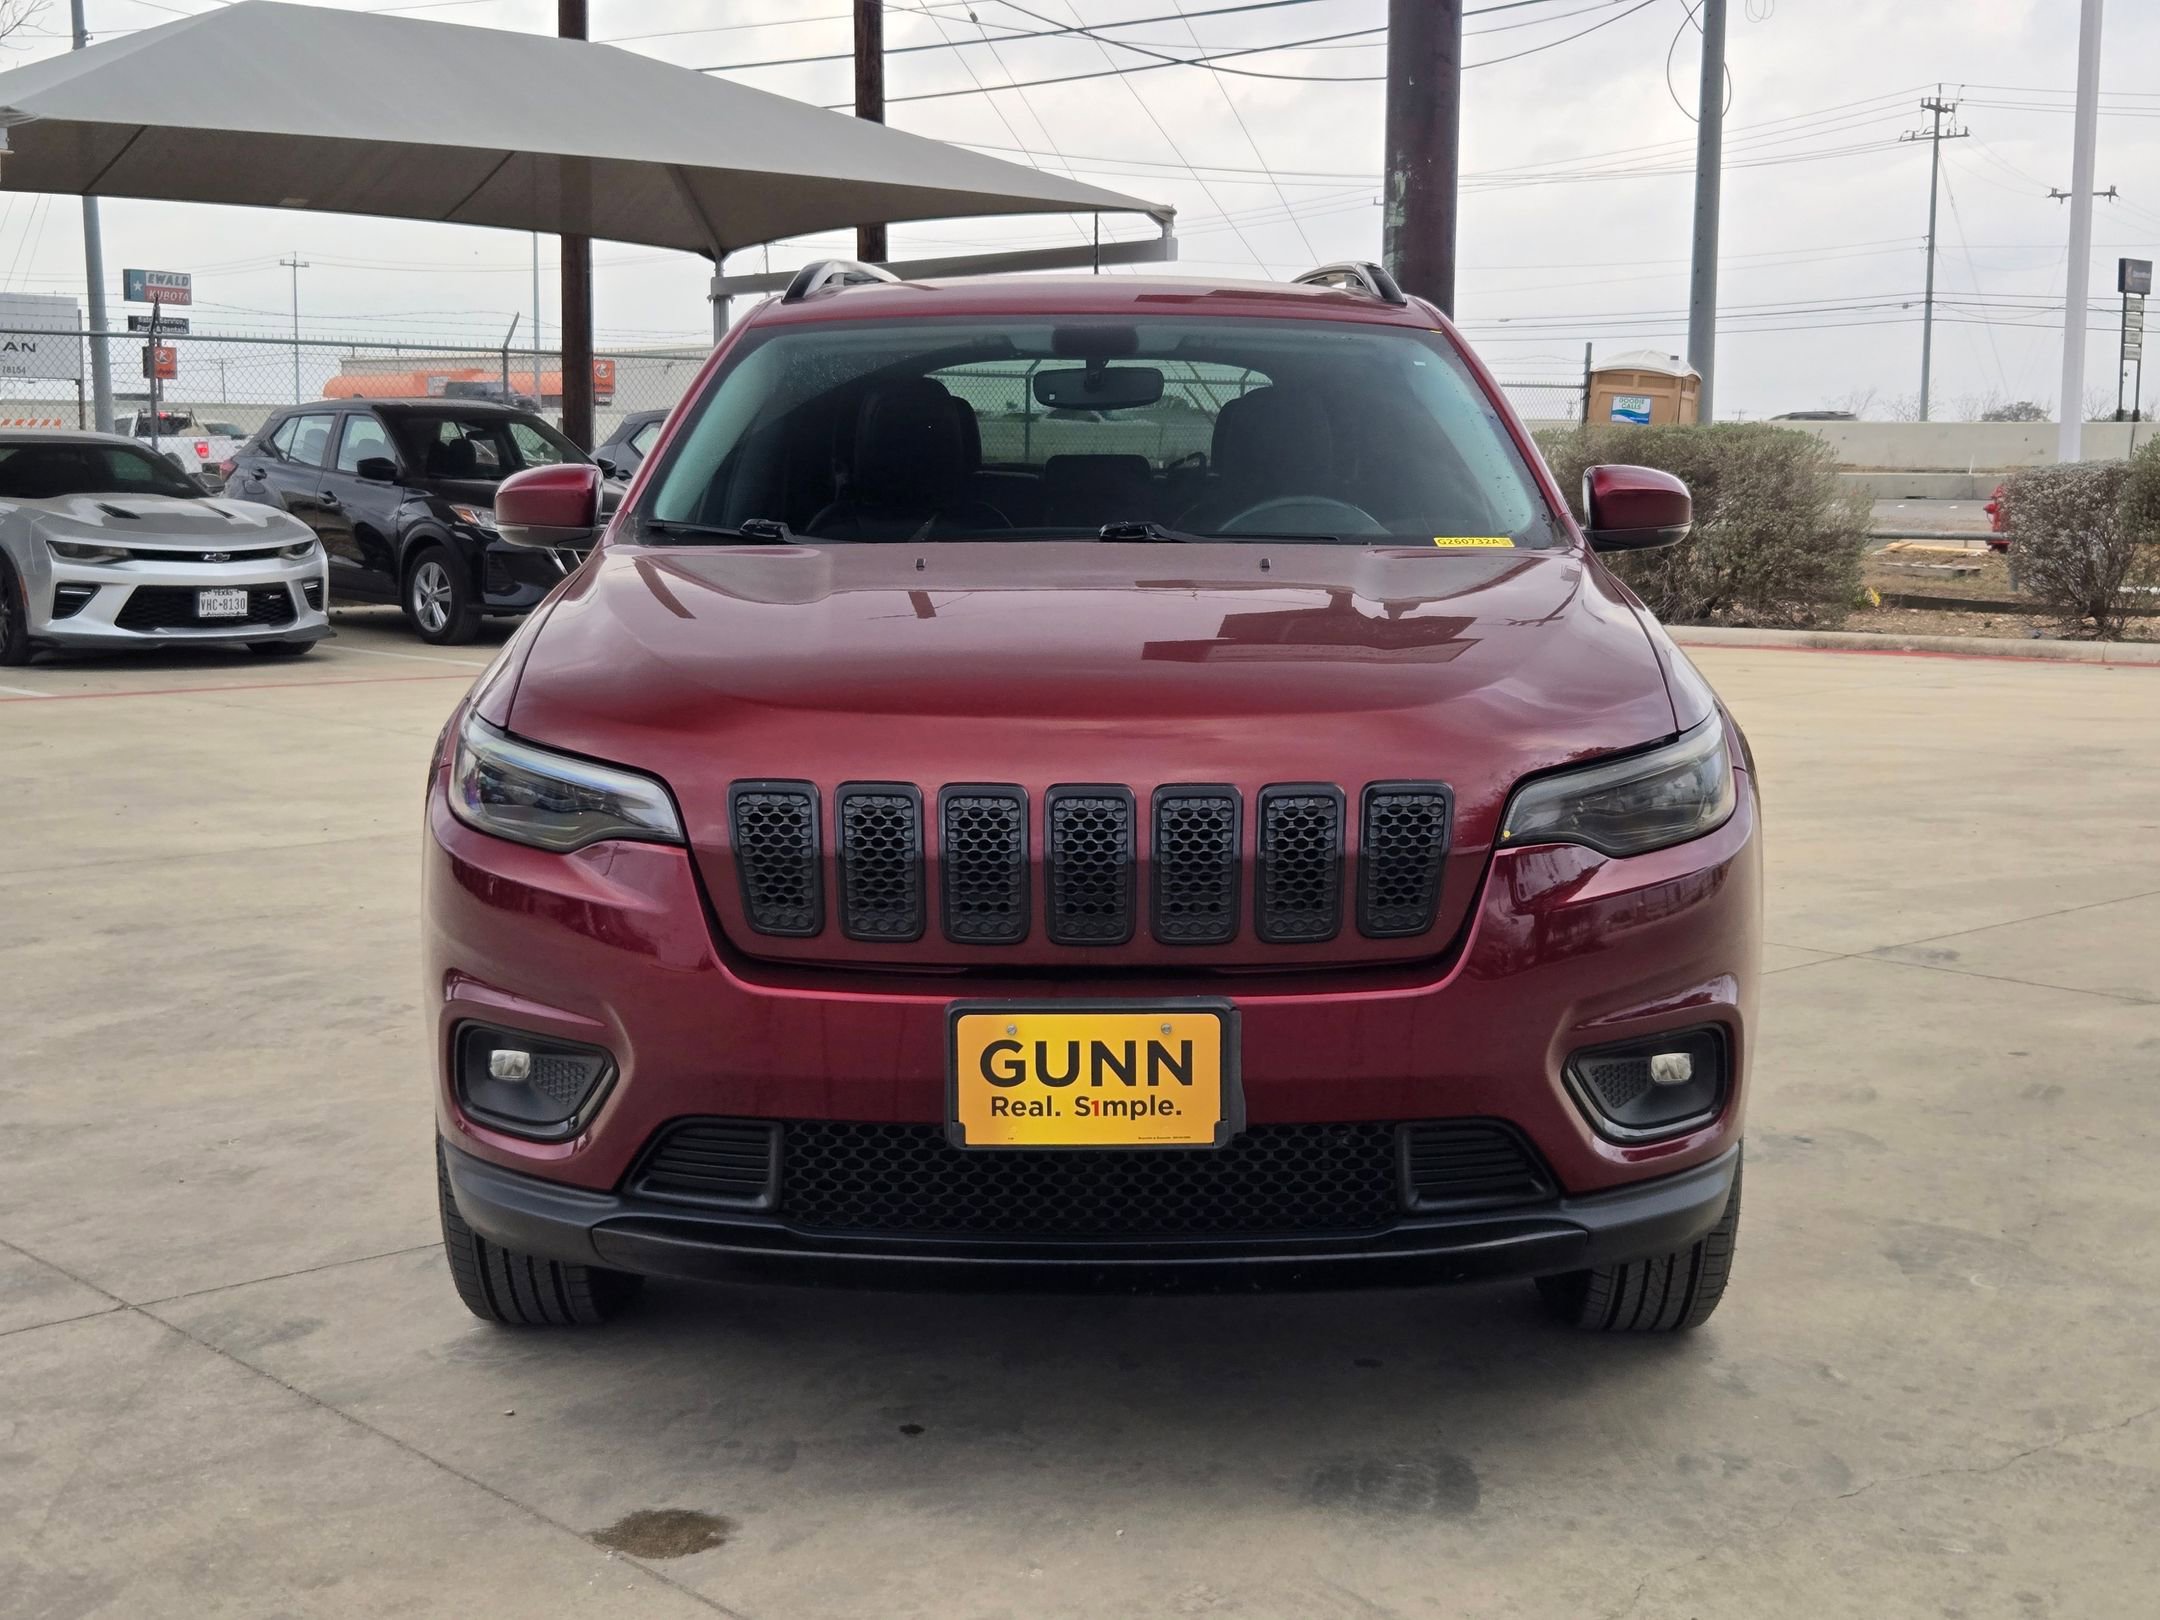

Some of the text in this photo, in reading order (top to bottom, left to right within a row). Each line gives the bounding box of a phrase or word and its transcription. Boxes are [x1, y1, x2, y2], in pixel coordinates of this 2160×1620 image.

[148, 273, 189, 286] EWALD
[149, 289, 189, 302] KUBOTA
[979, 1039, 1193, 1088] GUNN
[990, 1095, 1061, 1118] Real.
